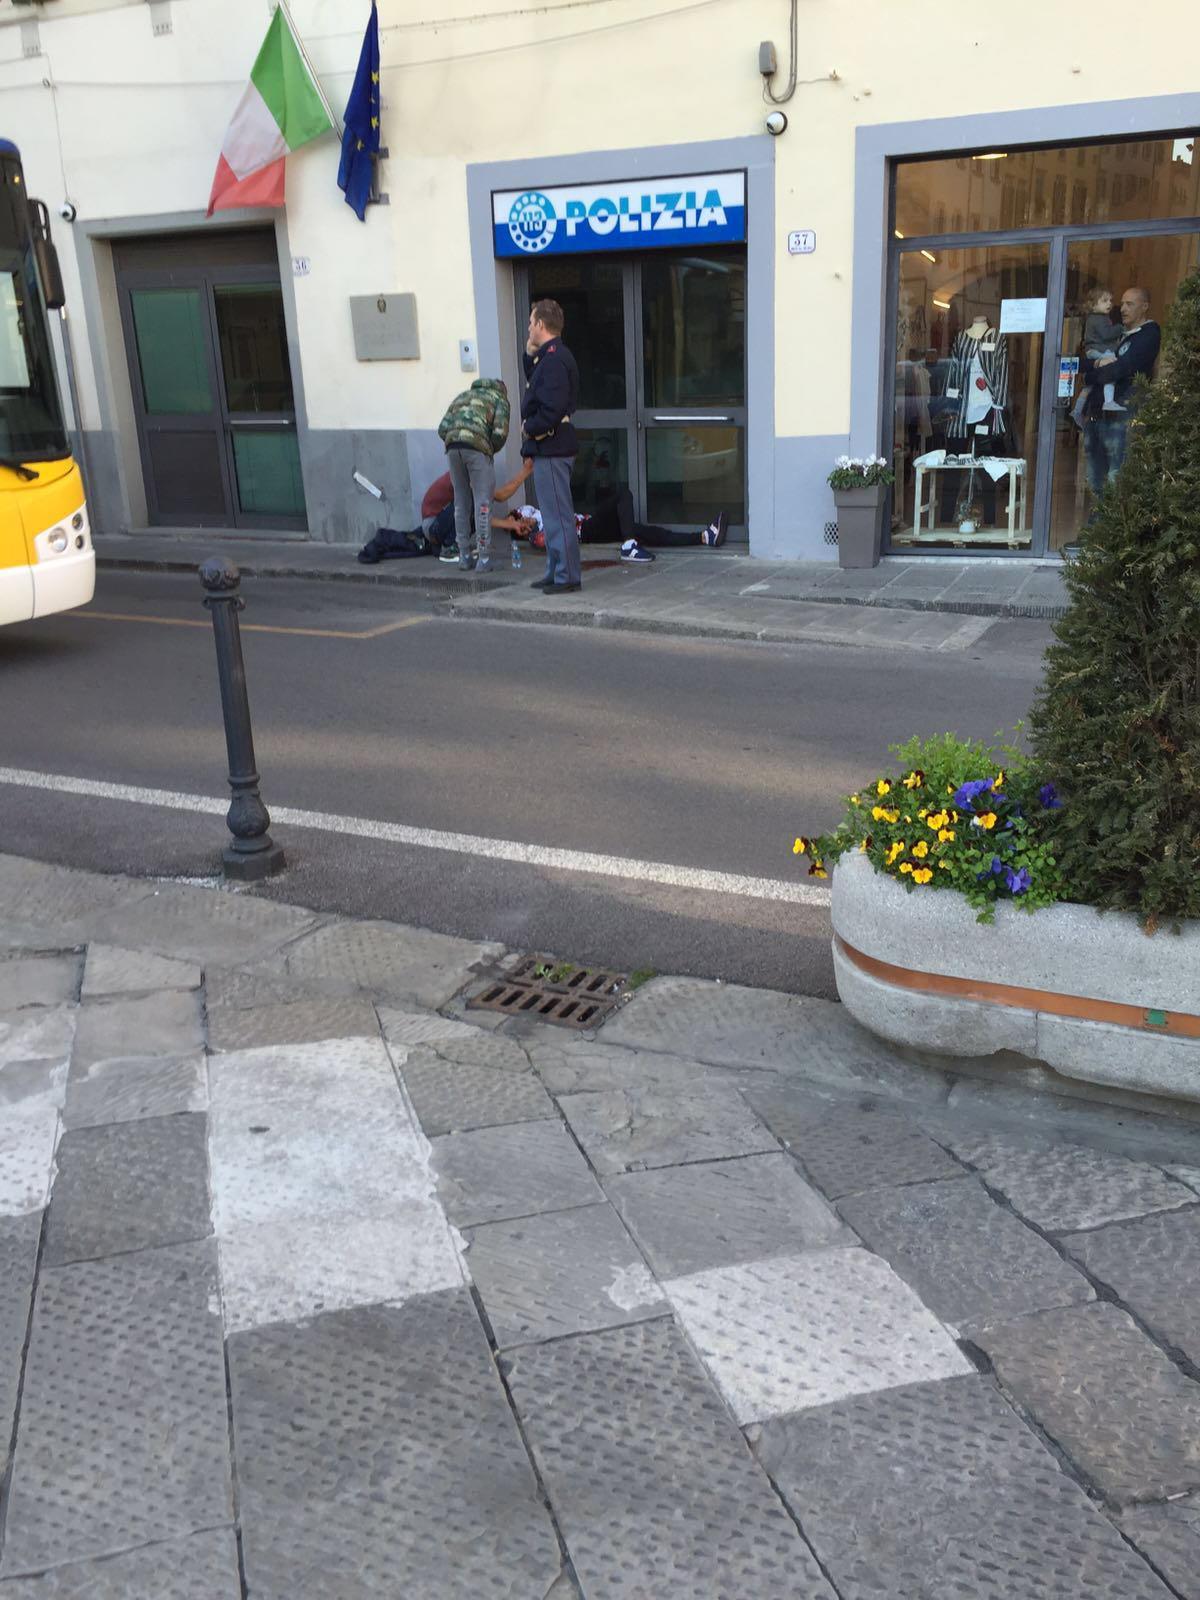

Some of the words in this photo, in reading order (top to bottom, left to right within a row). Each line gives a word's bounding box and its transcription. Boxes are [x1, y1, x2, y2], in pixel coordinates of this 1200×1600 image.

[523, 210, 543, 231] 113
[565, 188, 728, 237] POLIZIA
[794, 233, 808, 245] 37
